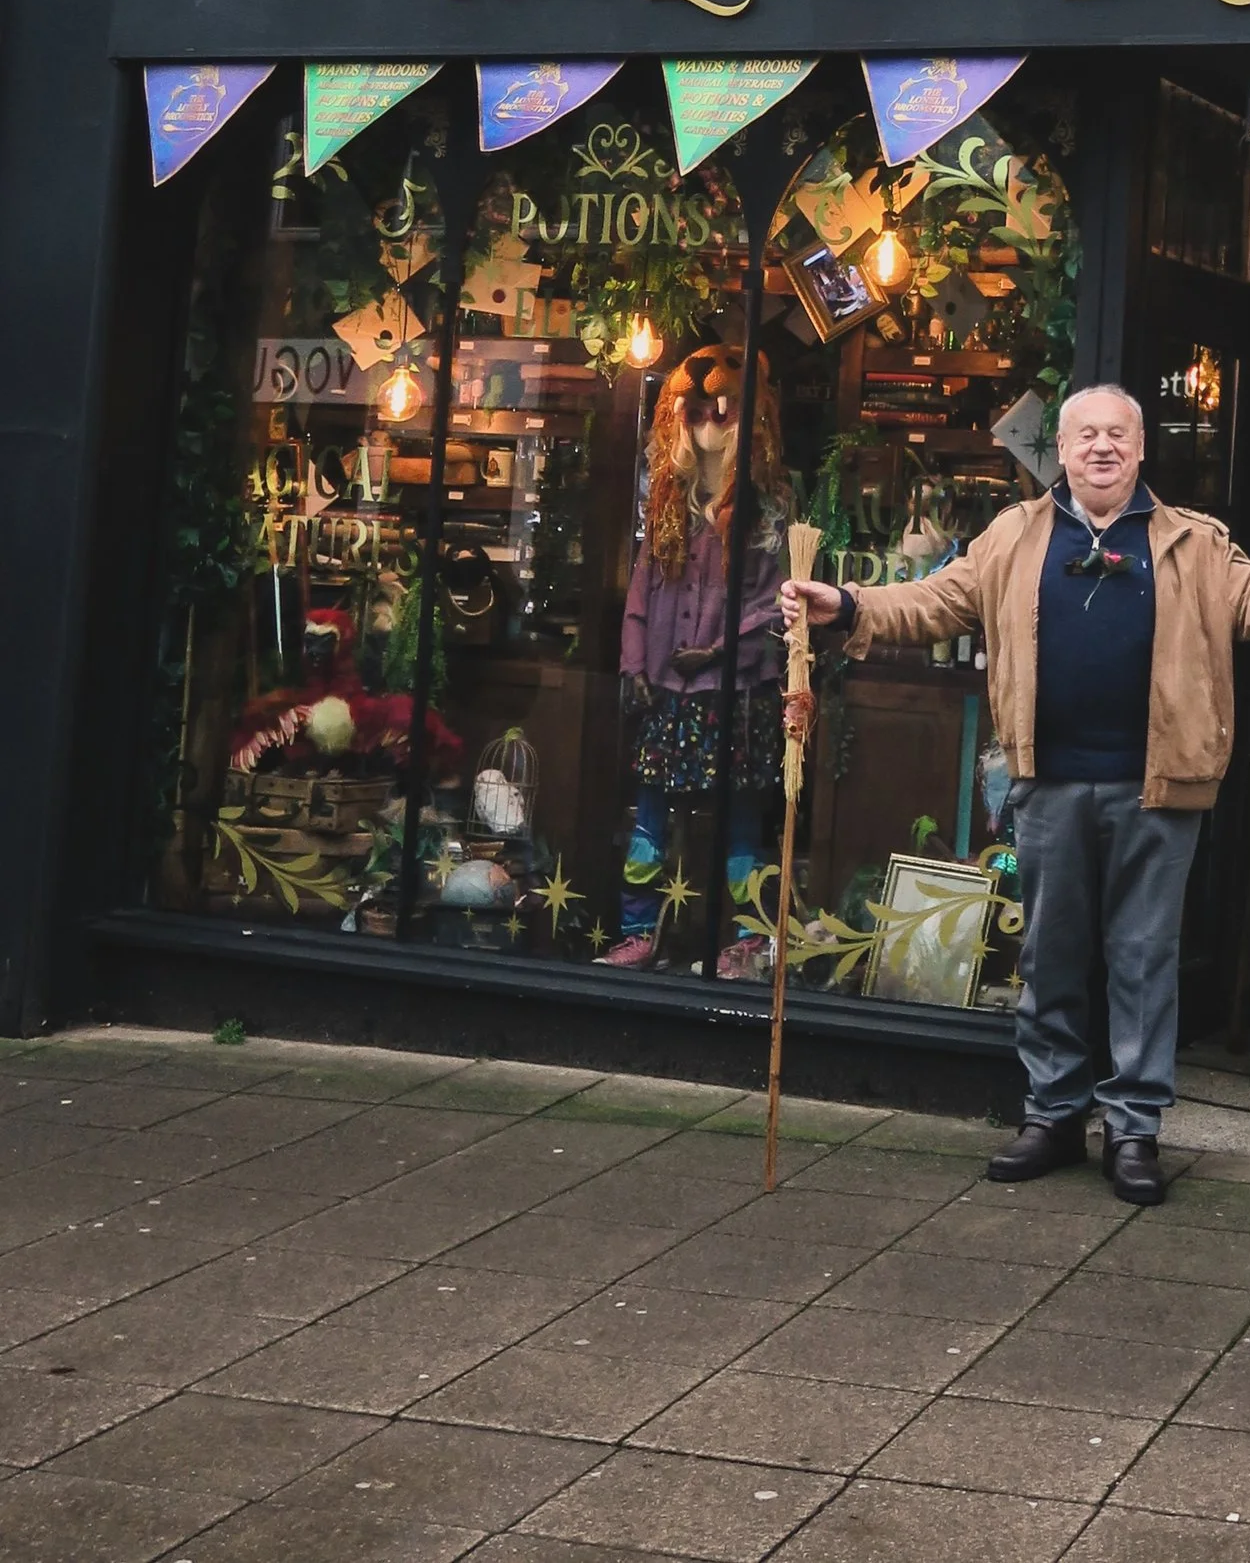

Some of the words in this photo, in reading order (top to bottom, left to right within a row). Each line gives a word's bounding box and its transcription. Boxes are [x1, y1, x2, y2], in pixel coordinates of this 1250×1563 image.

[316, 63, 362, 77] WANDS
[375, 63, 429, 77] BROOMS
[674, 59, 726, 74] WANDS
[728, 60, 739, 73] &
[742, 59, 802, 74] BROOMS
[679, 91, 750, 107] POTIONS
[752, 94, 766, 107] &
[511, 192, 710, 246] POTIONS
[248, 443, 403, 503] AGICAL
